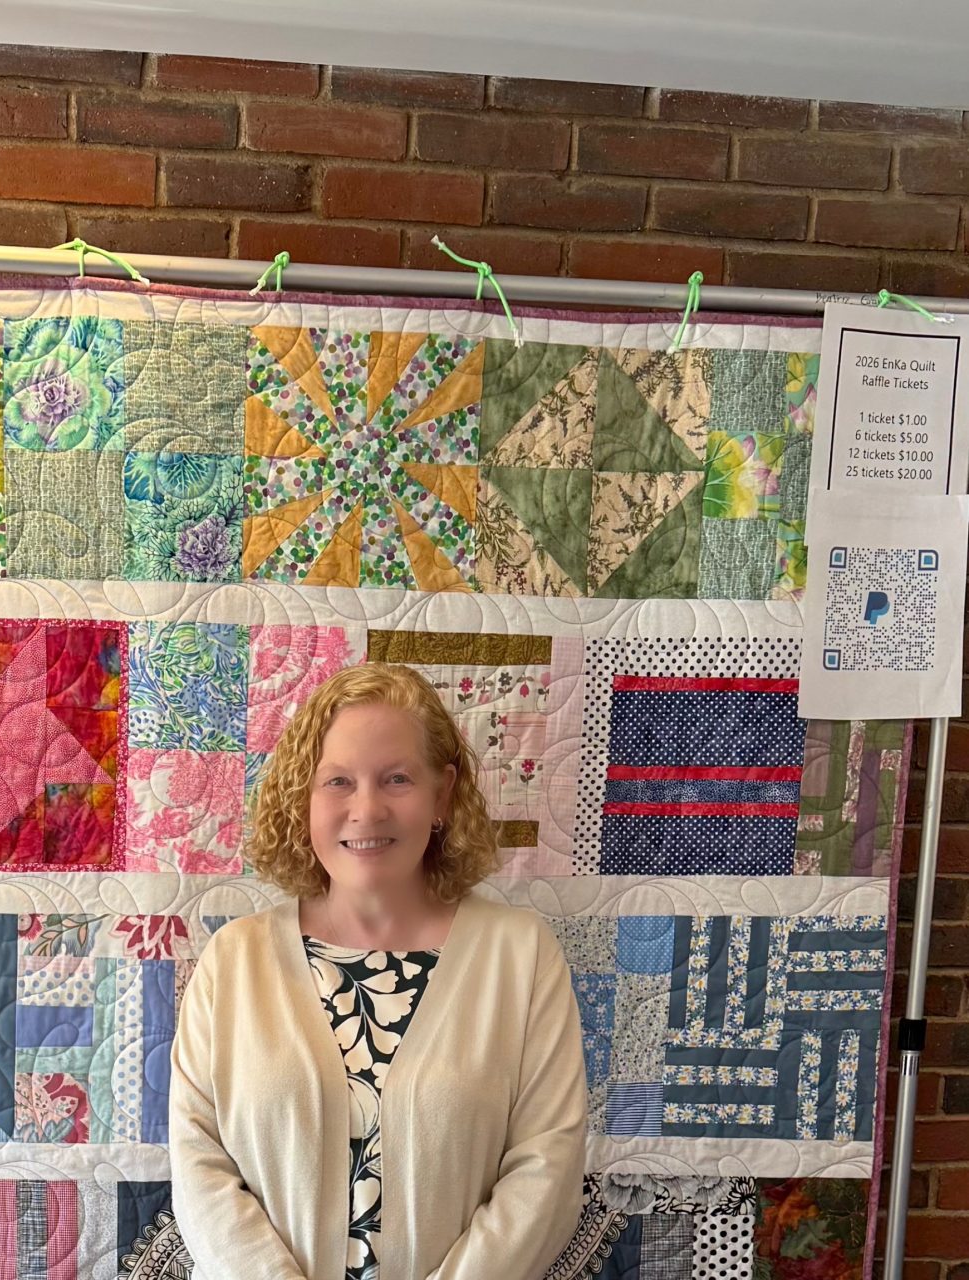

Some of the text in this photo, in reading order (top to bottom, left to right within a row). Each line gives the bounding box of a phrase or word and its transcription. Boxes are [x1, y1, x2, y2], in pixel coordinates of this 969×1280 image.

[855, 355, 936, 373] 2026 EnKa Quilt
[862, 374, 929, 390] Raffle Tickets
[859, 411, 927, 426] 1 ticket $1.00
[855, 429, 928, 444] 6 tickets $5.00
[848, 447, 934, 462] 12 tickets $10.00
[846, 465, 932, 480] 25 tickets $20.00
